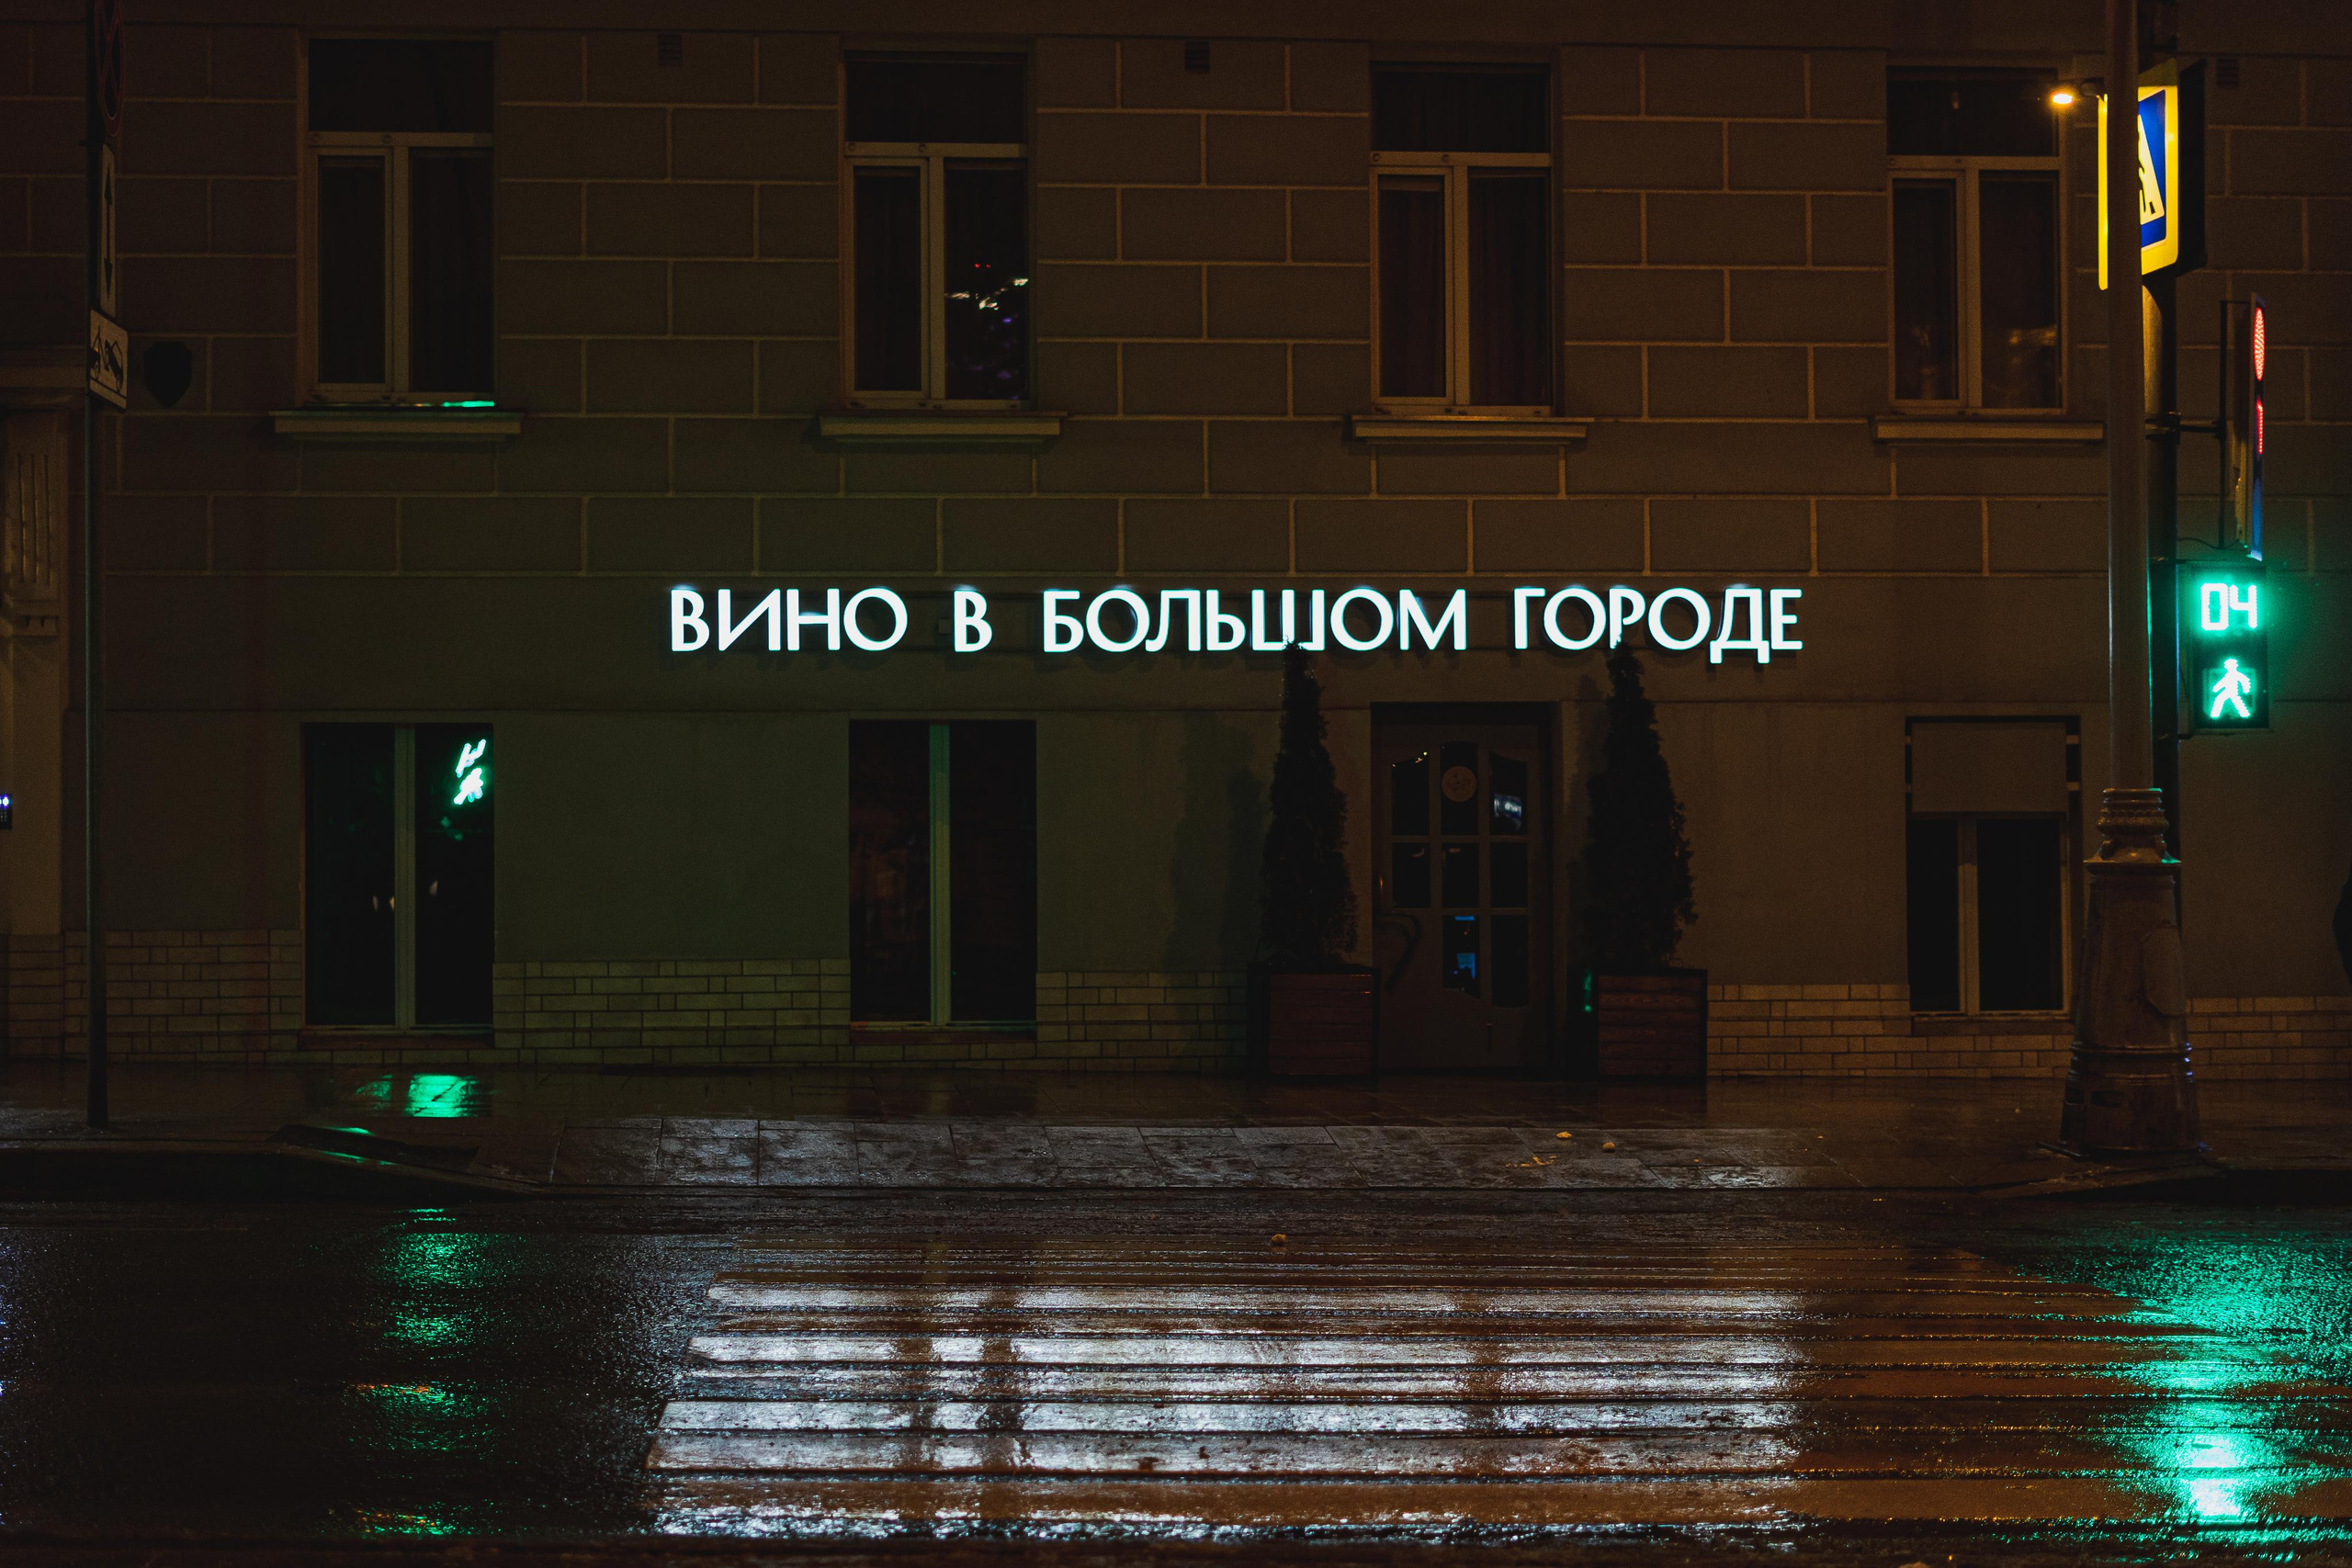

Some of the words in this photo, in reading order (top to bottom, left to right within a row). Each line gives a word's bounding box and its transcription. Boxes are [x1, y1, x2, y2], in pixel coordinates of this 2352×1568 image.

[670, 587, 908, 650] ВИНО
[953, 588, 992, 651] В
[1043, 589, 1466, 651] БОЛЬШОМ
[1513, 588, 1803, 663] ГОРОДЕ
[2200, 582, 2257, 630] 04
